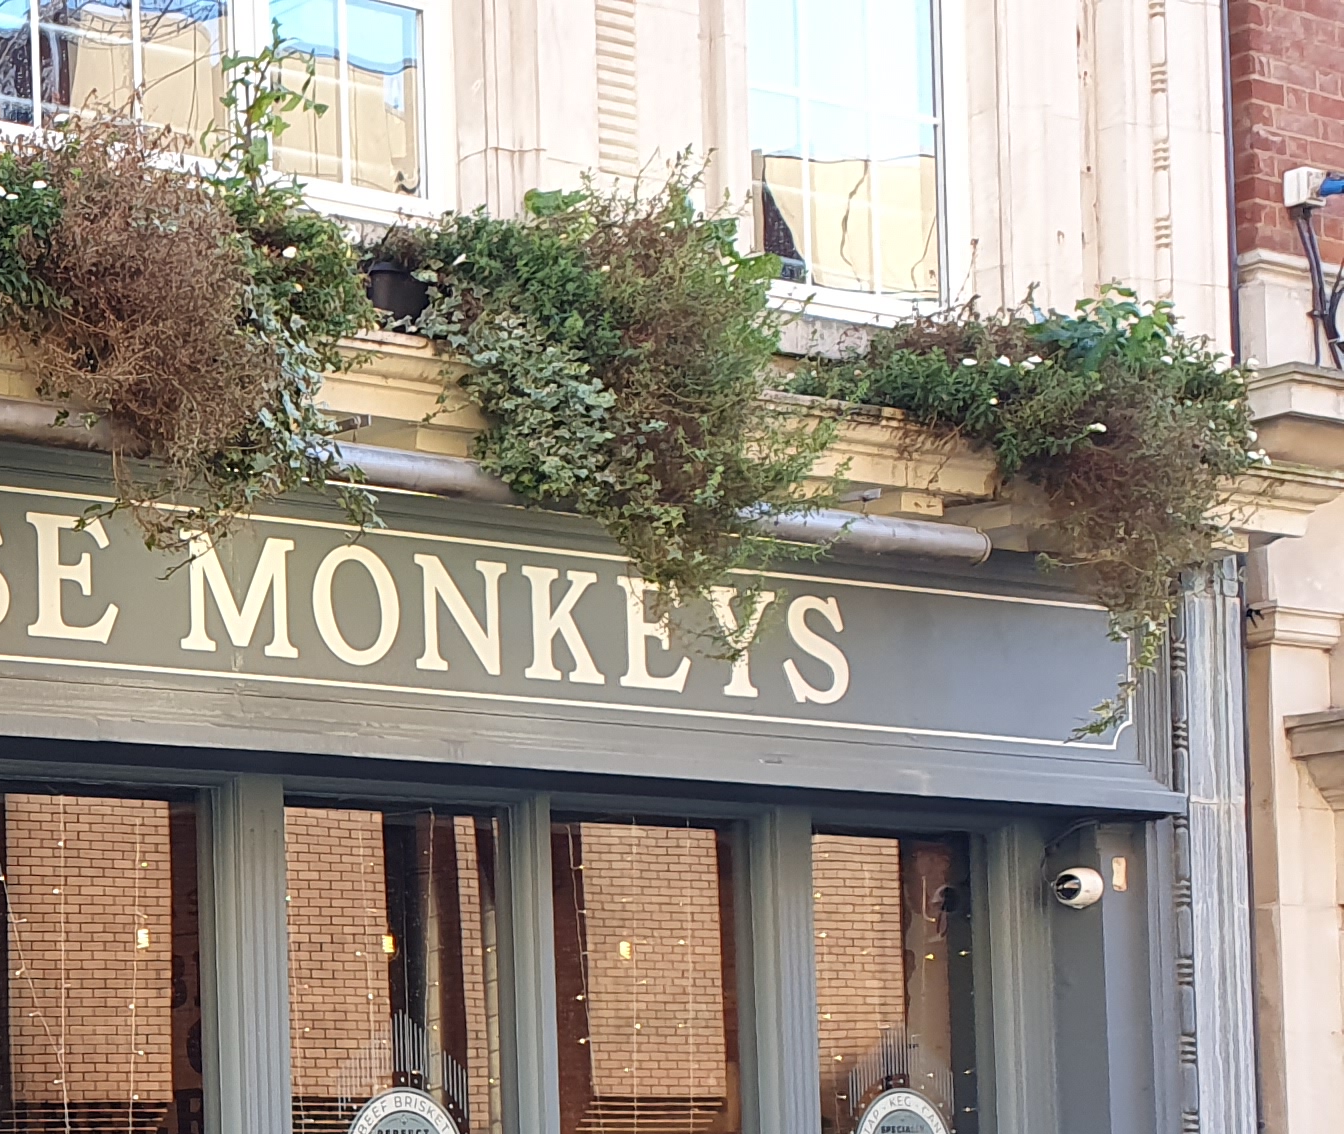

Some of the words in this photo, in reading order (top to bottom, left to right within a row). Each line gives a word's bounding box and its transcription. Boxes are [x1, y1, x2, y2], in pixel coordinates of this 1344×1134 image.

[179, 527, 850, 704] MONKEYS
[357, 1099, 387, 1134] BEEF
[394, 1096, 449, 1133] BRISKET
[864, 1109, 878, 1134] TAP
[889, 1096, 910, 1107] KEG
[921, 1106, 941, 1133] CAN
